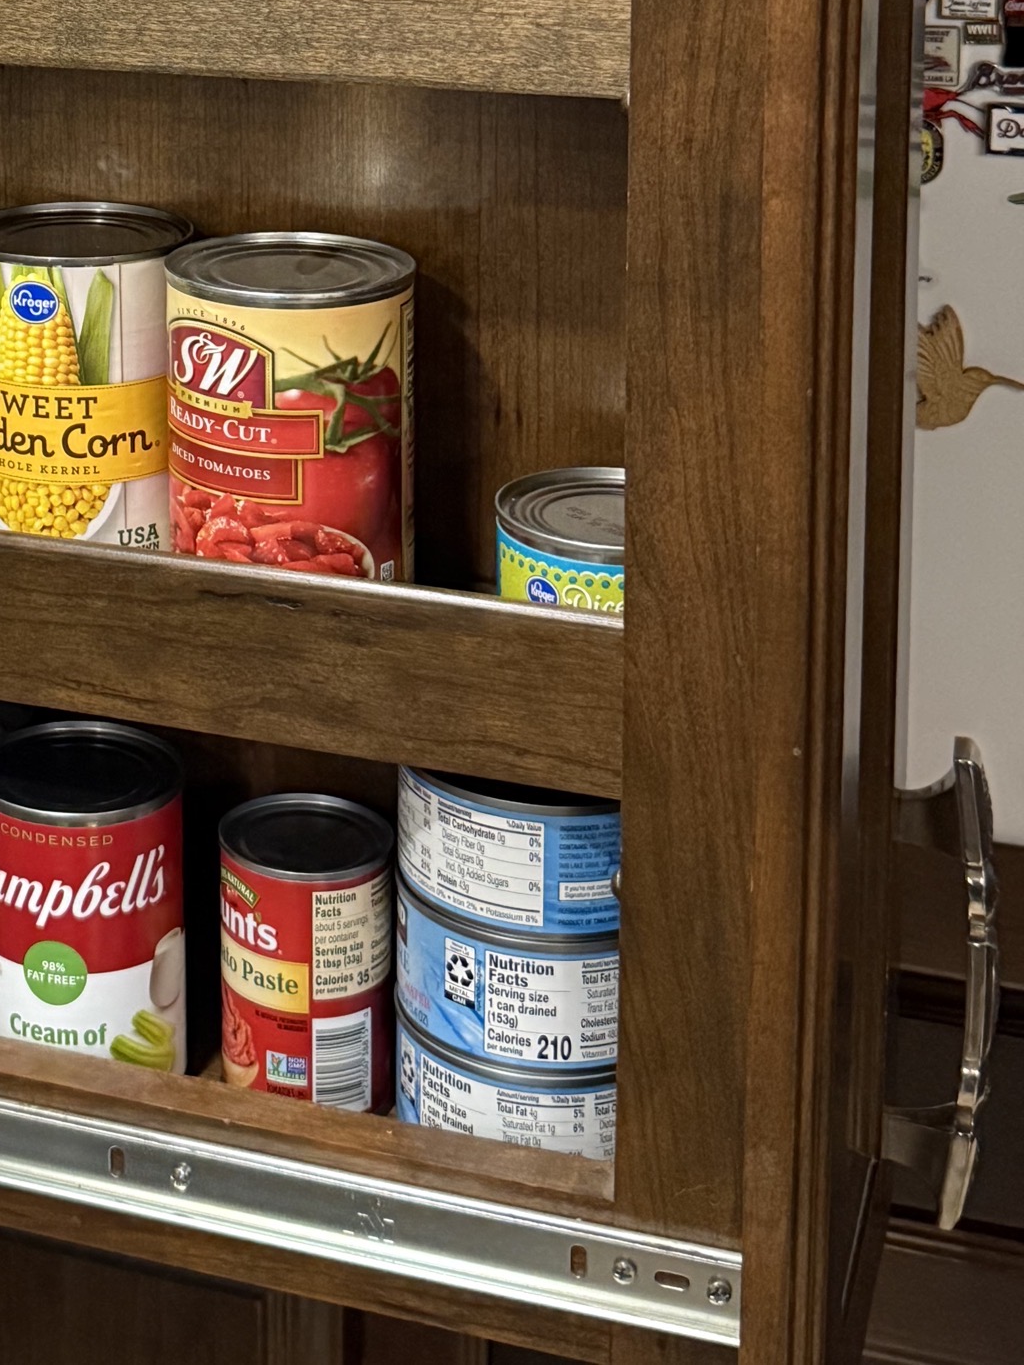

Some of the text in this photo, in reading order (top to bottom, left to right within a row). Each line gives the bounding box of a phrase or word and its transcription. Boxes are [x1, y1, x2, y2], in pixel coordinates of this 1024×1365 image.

[13, 289, 56, 316] Kroger
[177, 307, 247, 332] SINCE 1896
[174, 332, 259, 396] S&W
[180, 389, 241, 414] PREMIUM
[169, 395, 272, 443] READY-CUT
[61, 423, 153, 459] Corn
[40, 463, 101, 475] KERNEL
[171, 443, 272, 481] DICED TOMATOES
[118, 522, 160, 543] USA
[0, 822, 114, 848] CONDENSED
[227, 875, 255, 904] NATURAL
[26, 968, 46, 983] FAT
[41, 959, 66, 973] 98%
[242, 958, 299, 995] Paste
[488, 953, 555, 976] Nutrition
[488, 967, 529, 988] Facts
[448, 984, 470, 998] METAL
[451, 994, 467, 1006] CAN
[487, 983, 549, 1003] Serving size
[9, 1012, 107, 1047] Cream of
[487, 1028, 532, 1047] Calories
[486, 1042, 524, 1057] per serving
[537, 1034, 572, 1061] 210
[288, 1056, 306, 1065] NON
